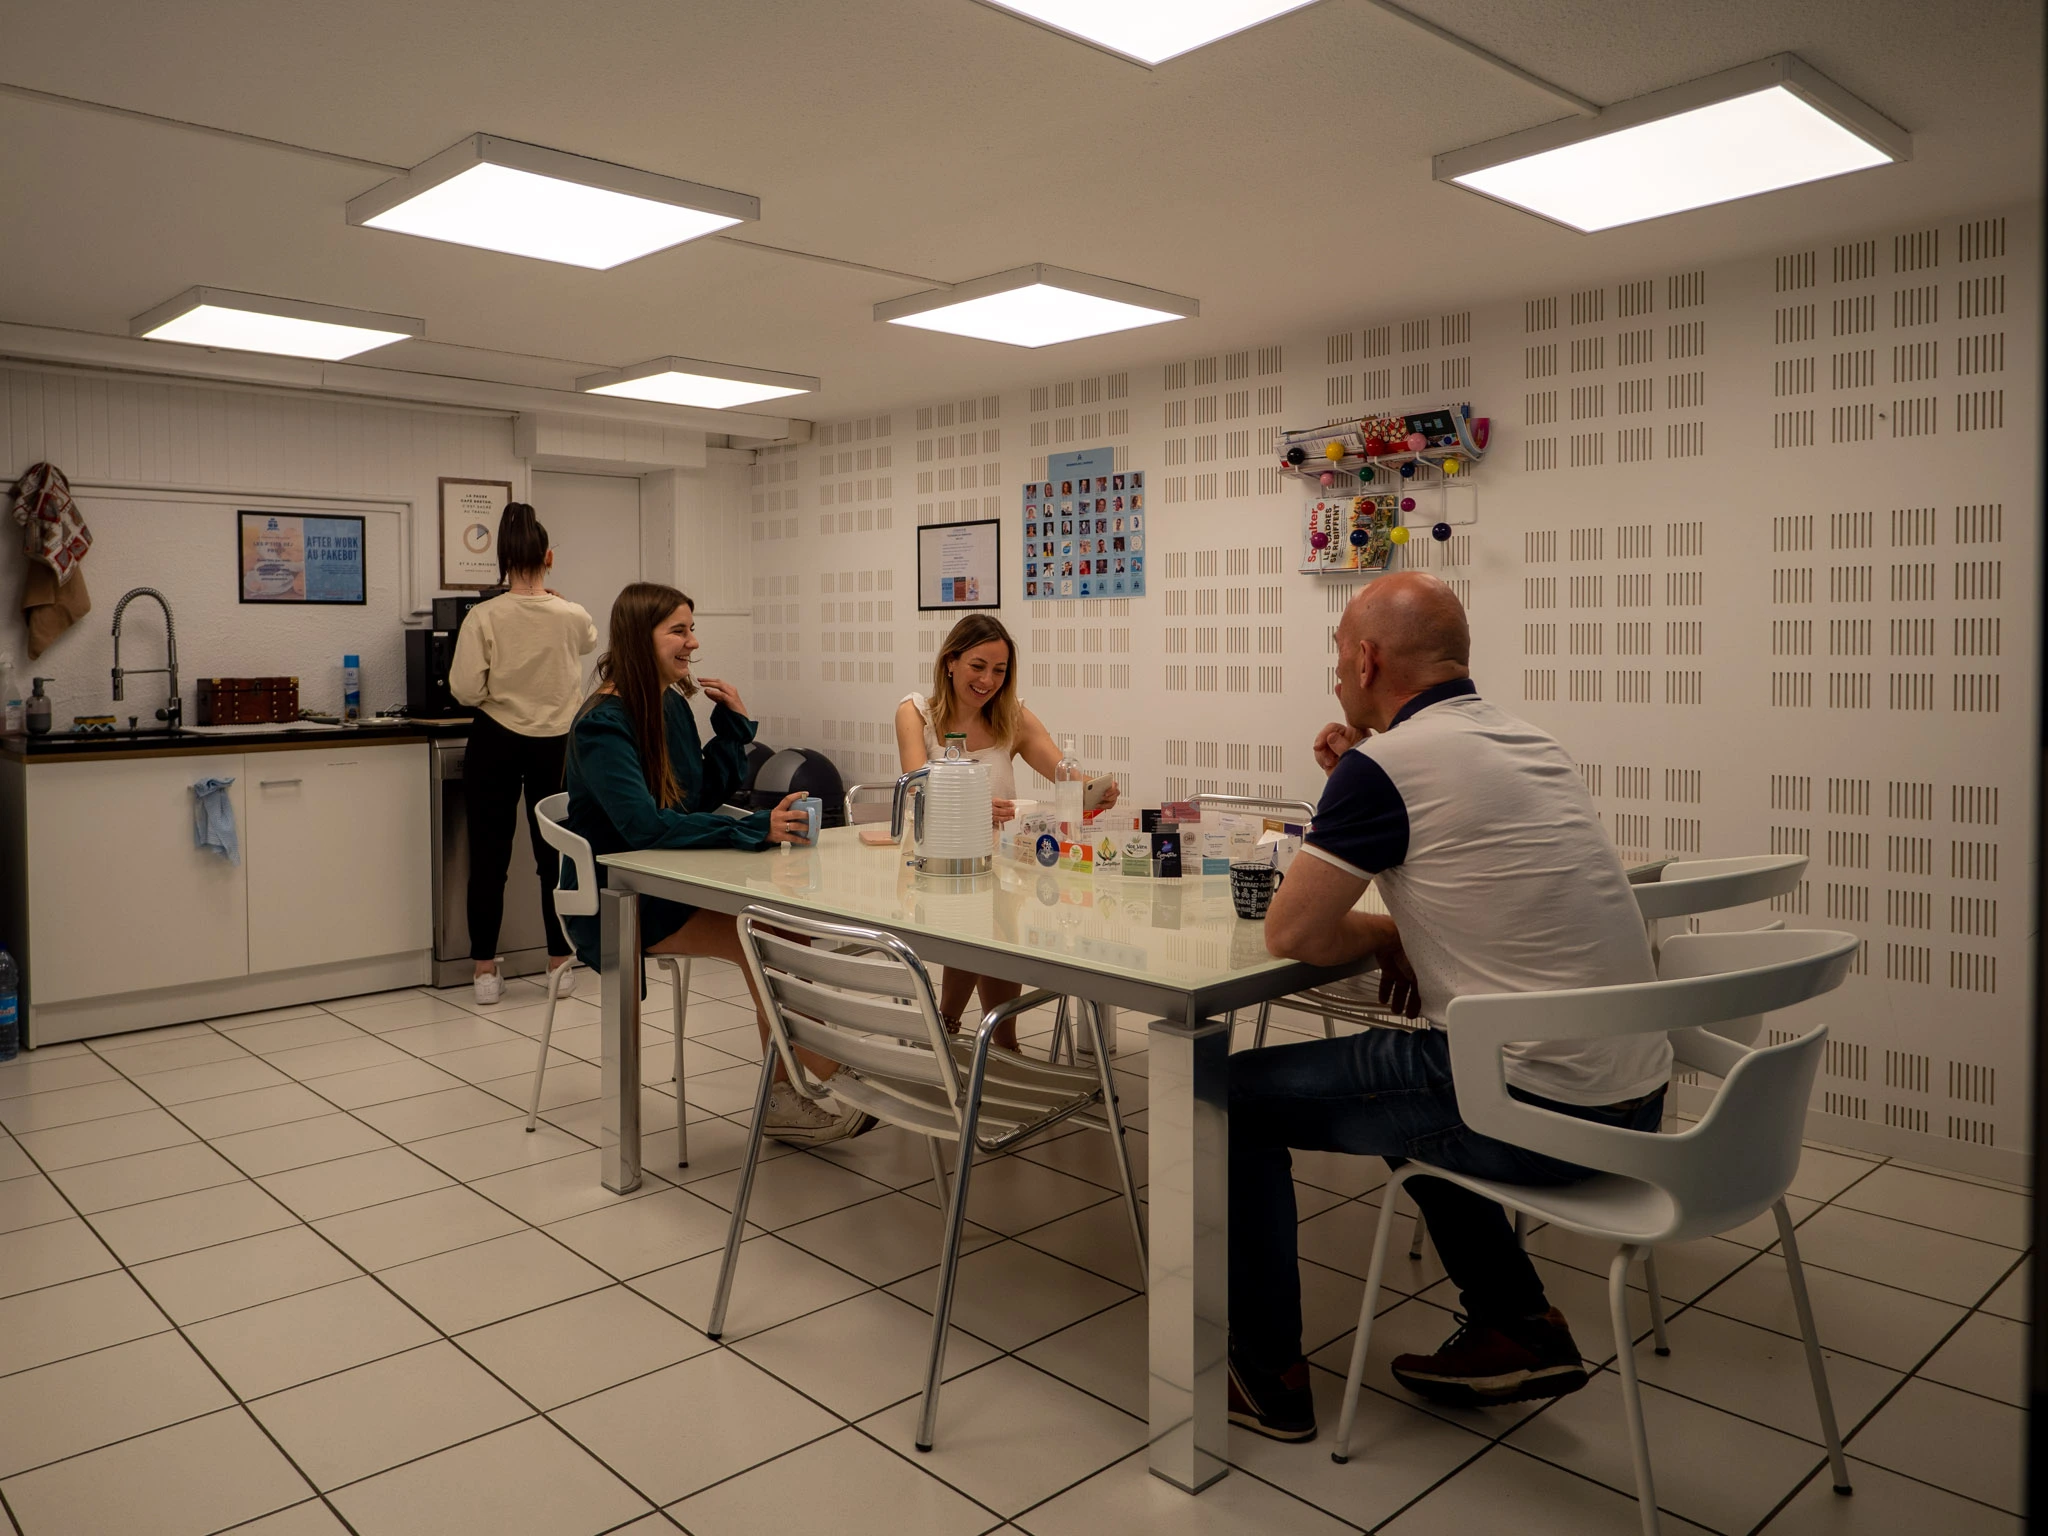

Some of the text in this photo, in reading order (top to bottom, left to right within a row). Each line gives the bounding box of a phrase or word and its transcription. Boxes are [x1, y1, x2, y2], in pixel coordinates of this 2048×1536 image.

[1307, 508, 1318, 563] Soalter
[1330, 504, 1340, 563] SE REBIFFENT
[306, 535, 359, 549] AFTER WORK
[307, 549, 358, 561] AU PAKEBOT
[1323, 546, 1331, 561] LES
